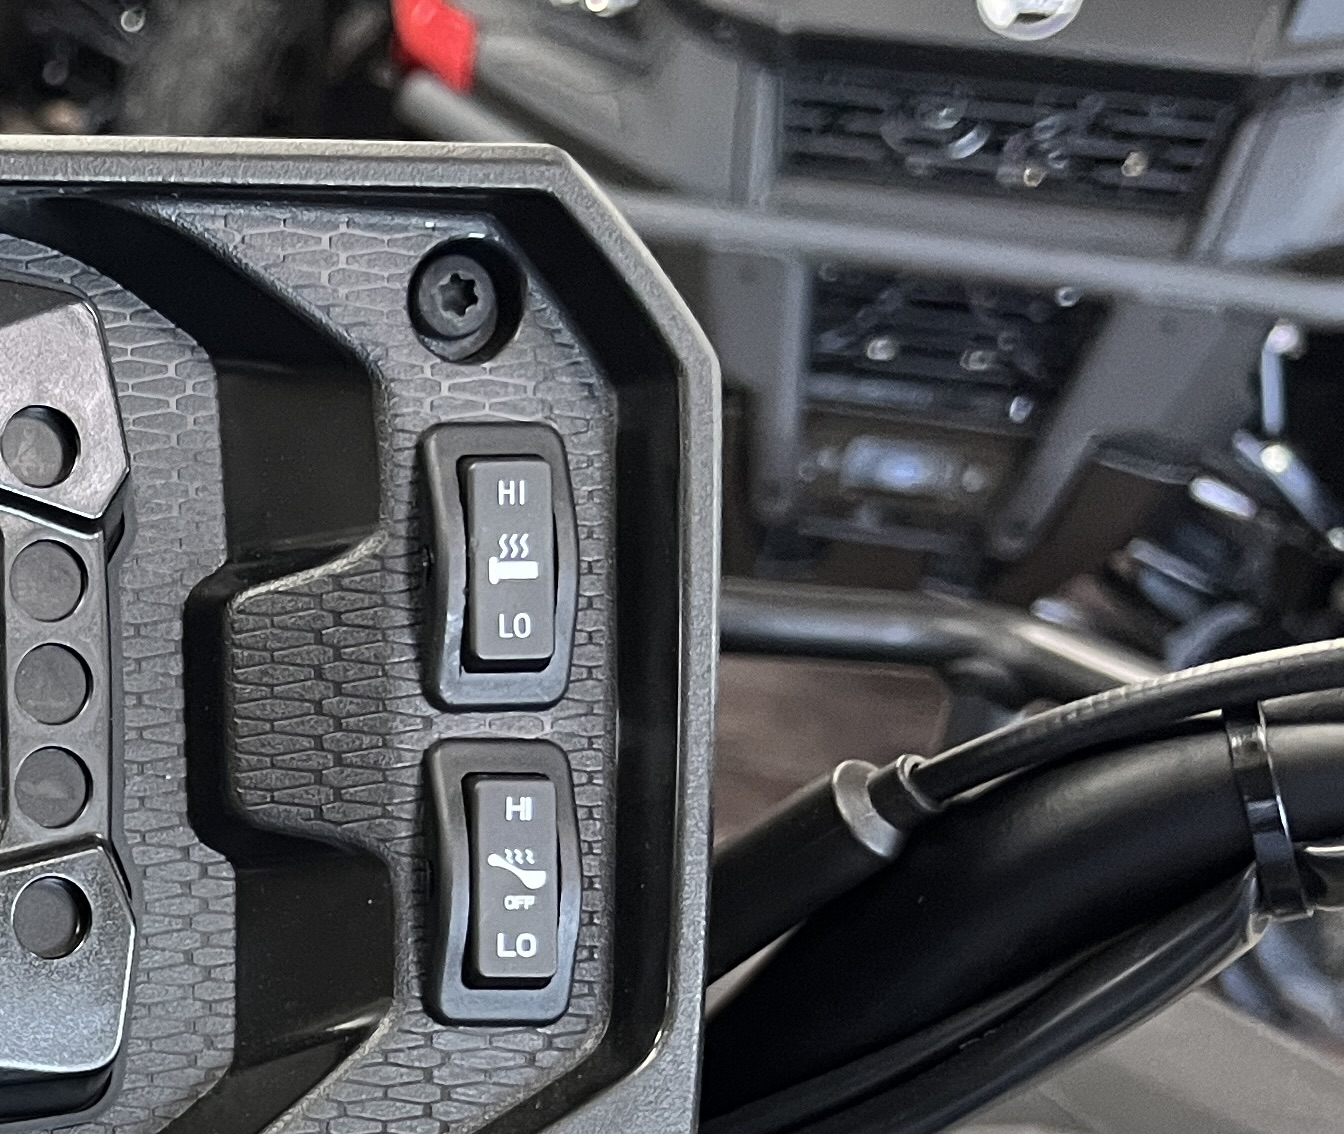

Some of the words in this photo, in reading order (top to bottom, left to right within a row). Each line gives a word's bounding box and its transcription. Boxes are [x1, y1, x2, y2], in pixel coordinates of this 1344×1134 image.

[498, 480, 526, 505] HI
[498, 613, 531, 638] LO
[505, 796, 534, 821] HI
[504, 895, 535, 910] OFF
[497, 932, 537, 957] LO
